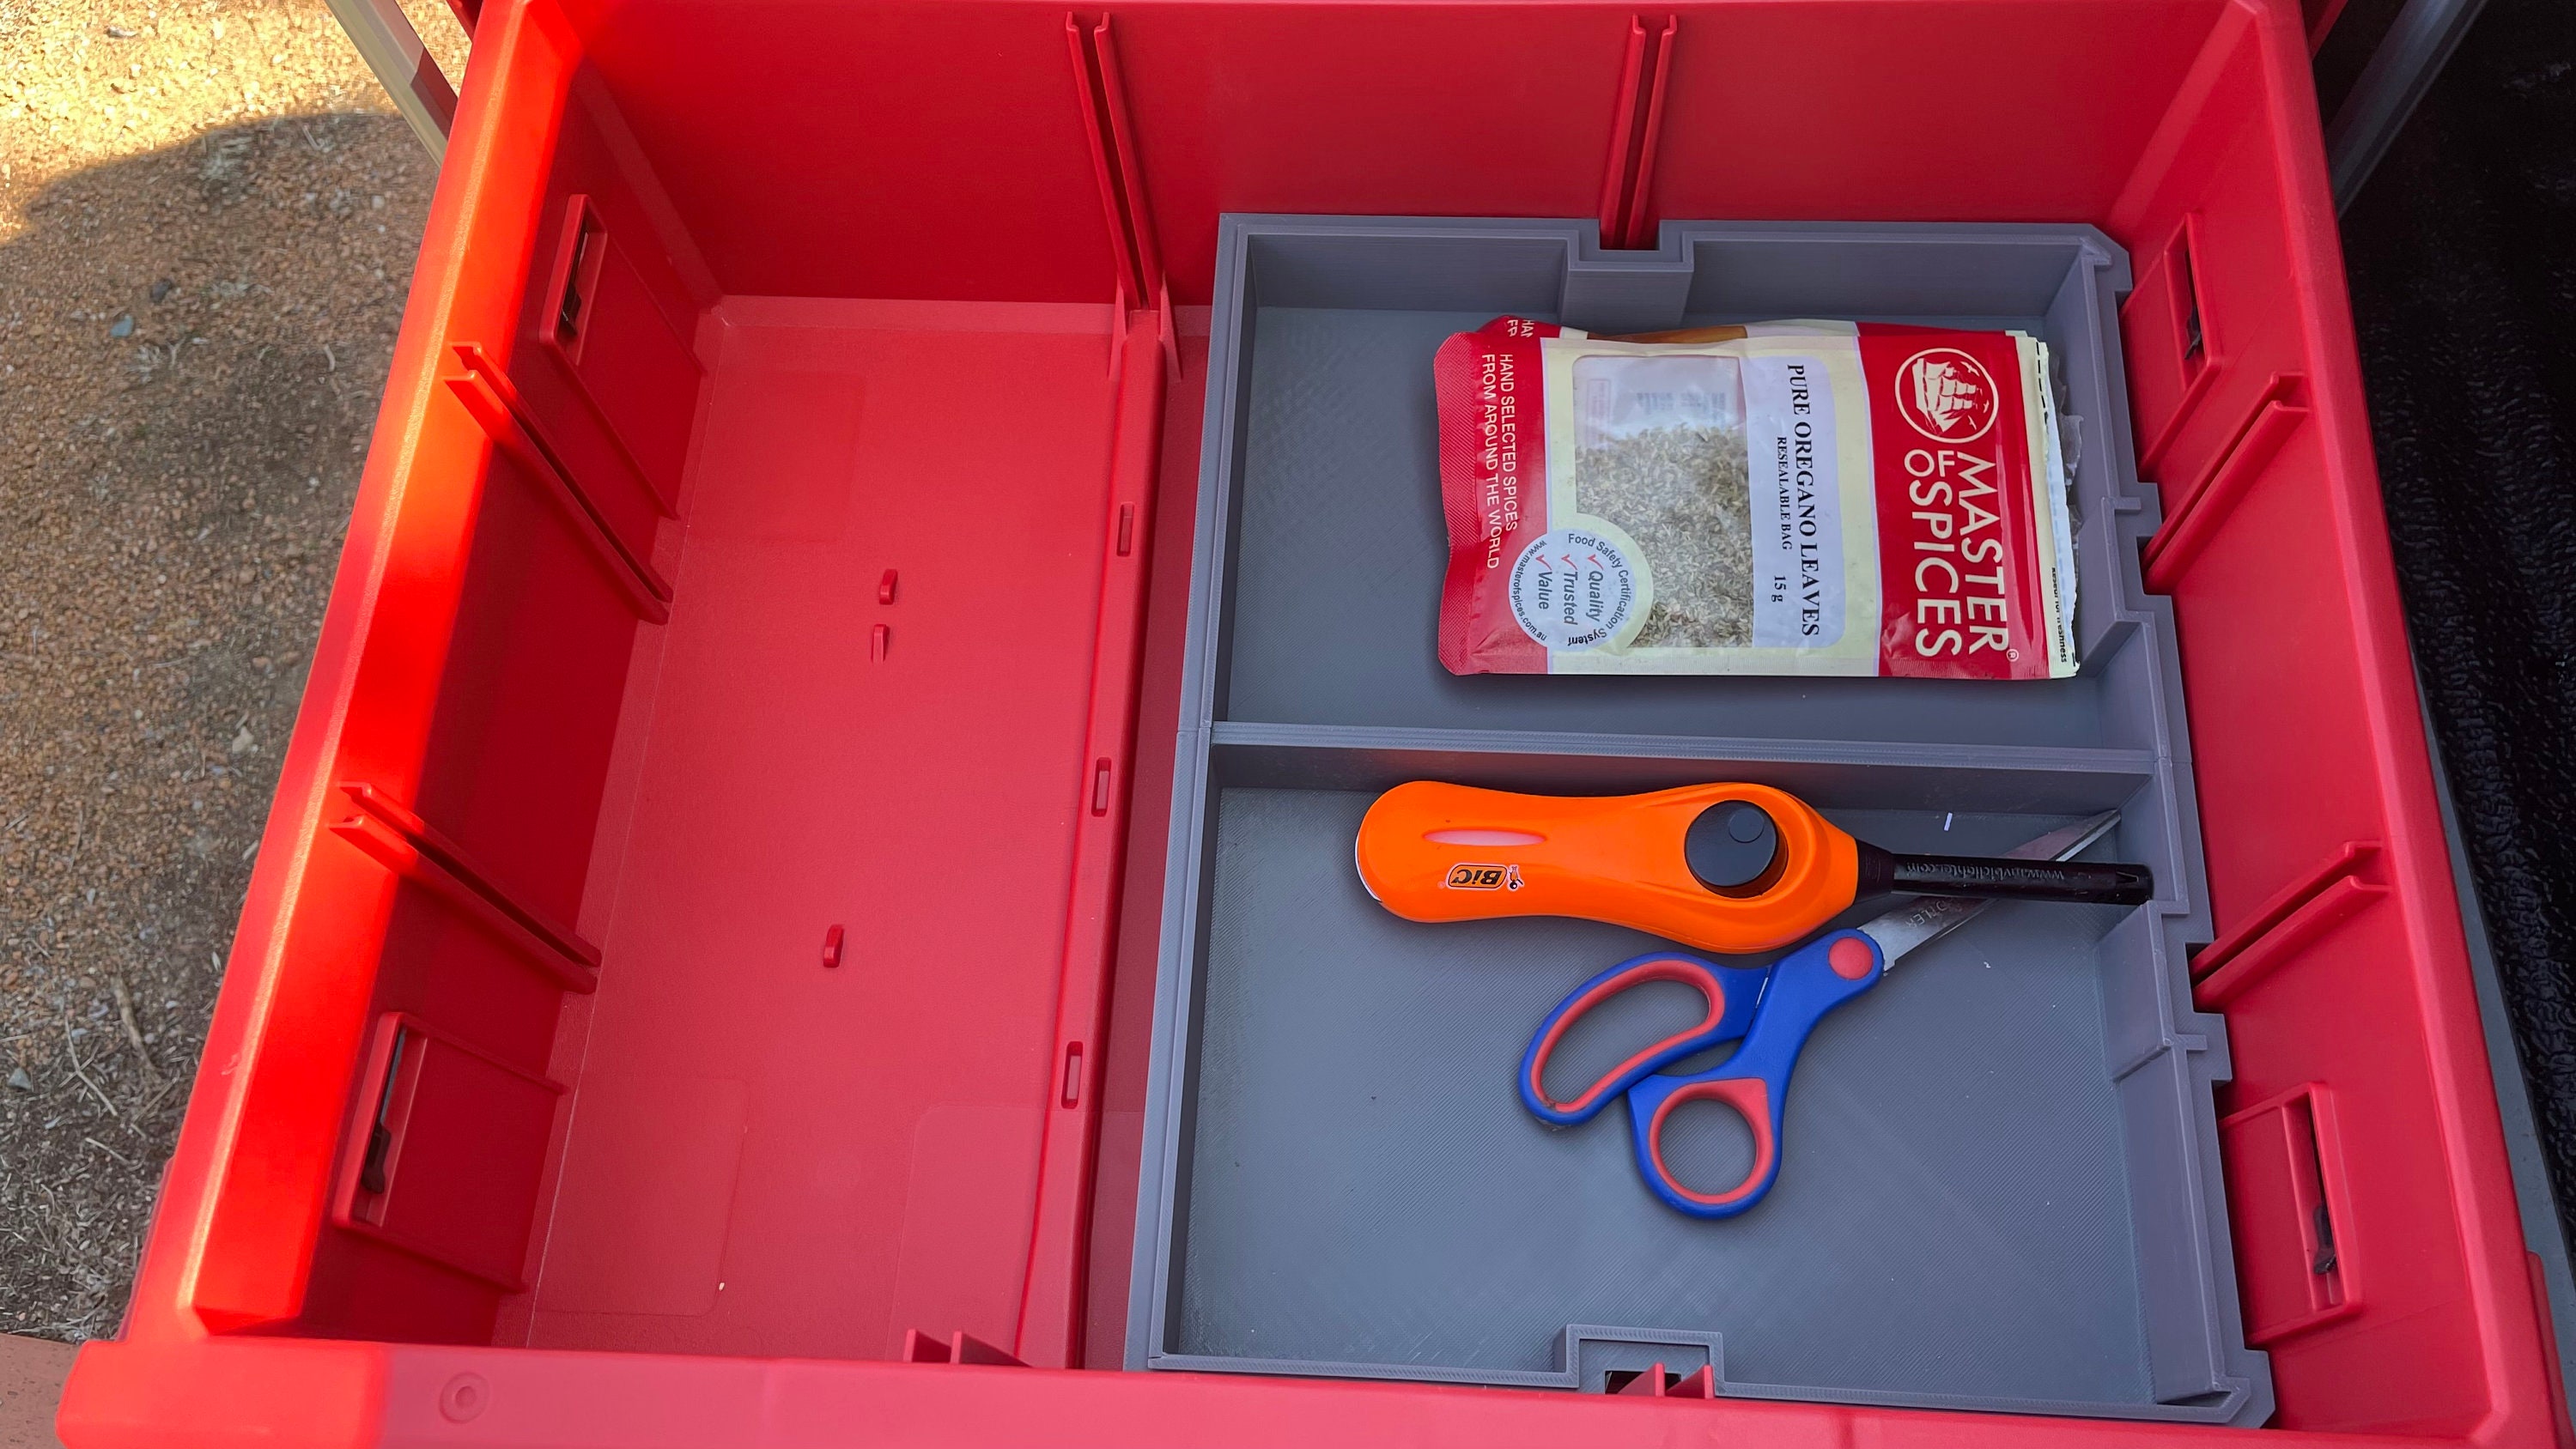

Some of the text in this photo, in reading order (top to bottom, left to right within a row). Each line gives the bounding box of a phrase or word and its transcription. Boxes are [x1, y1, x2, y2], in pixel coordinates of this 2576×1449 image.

[1507, 319, 1519, 336] FR
[1520, 319, 1534, 337] HAN
[1482, 354, 1502, 569] FROM AROUND THE WORLD
[1499, 354, 1518, 531] HAND SELECTED SPICES
[1777, 436, 1793, 550] RESEALABLE BAG
[1904, 449, 1955, 477] OF
[1787, 364, 1820, 636] PURE OREGANO LEAVES
[1511, 540, 1547, 641] www.masterofspices.com.au
[1538, 571, 1553, 610] Value
[1563, 571, 1578, 626] Trusted
[1567, 533, 1632, 646] Food Safety Certification System
[1586, 570, 1604, 623] Quality
[1771, 575, 1787, 603] 15 g
[1909, 479, 1963, 658] SPICES
[1956, 451, 2009, 655] MASTER
